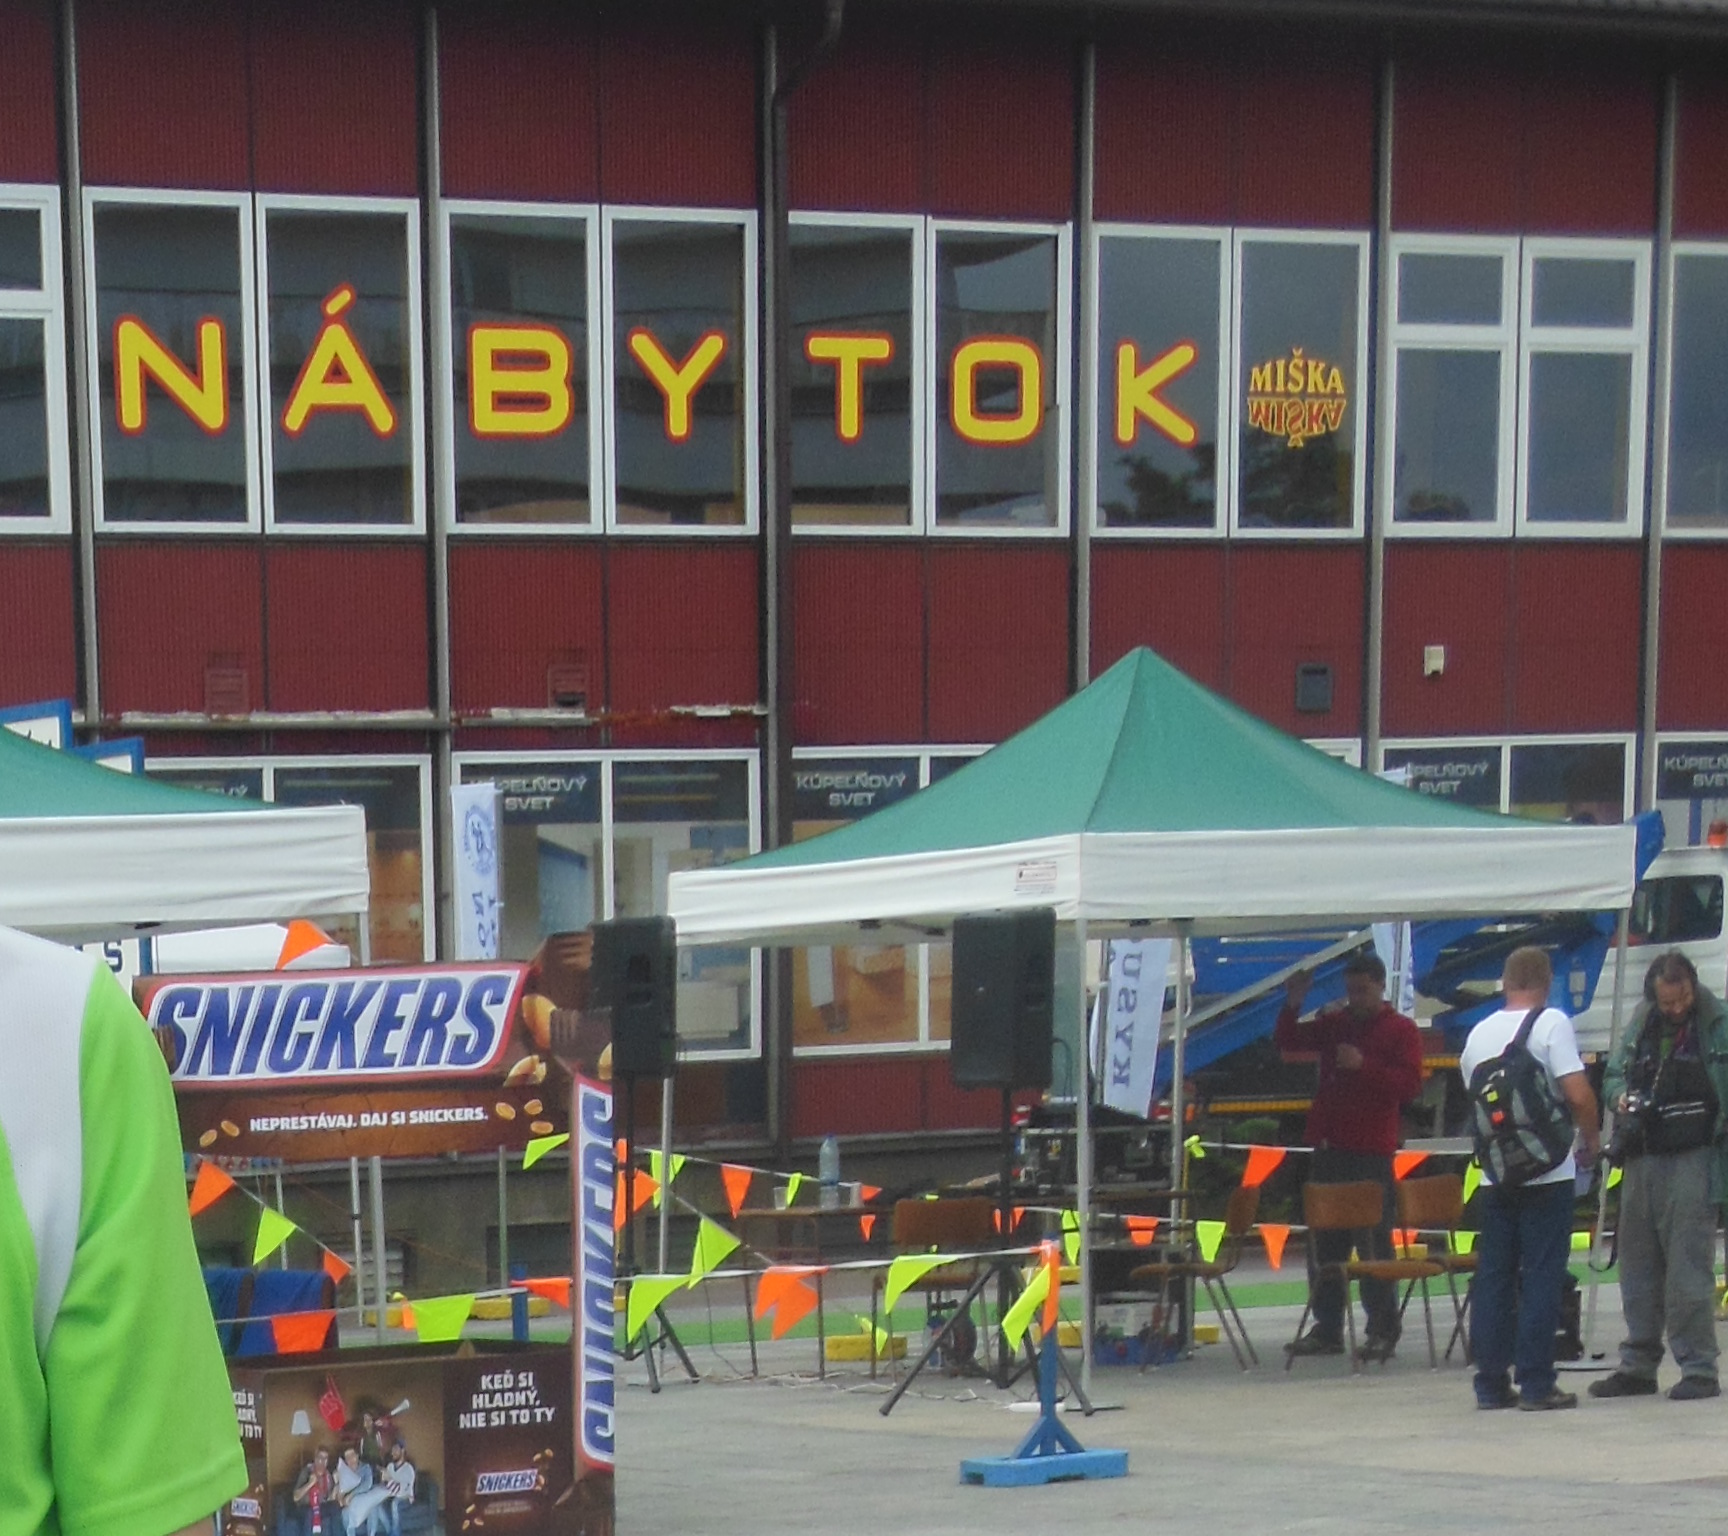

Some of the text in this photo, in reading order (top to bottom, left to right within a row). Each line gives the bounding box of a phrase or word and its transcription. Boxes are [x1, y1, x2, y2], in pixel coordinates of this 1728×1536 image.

[113, 283, 1198, 447] NÁBYTOK
[1249, 347, 1345, 394] MIŠKA
[505, 796, 555, 811] SVET
[829, 792, 875, 807] SVET
[156, 974, 513, 1077] SNICKERS
[250, 1106, 489, 1132] NEPRESTÁVAJ. DAJ SI SNICKERS.
[481, 1369, 534, 1391] KEĎ SI
[472, 1386, 541, 1409] HLADNÝ,
[459, 1407, 555, 1429] NIE SI TO TY
[477, 1470, 537, 1493] SNICKERS
